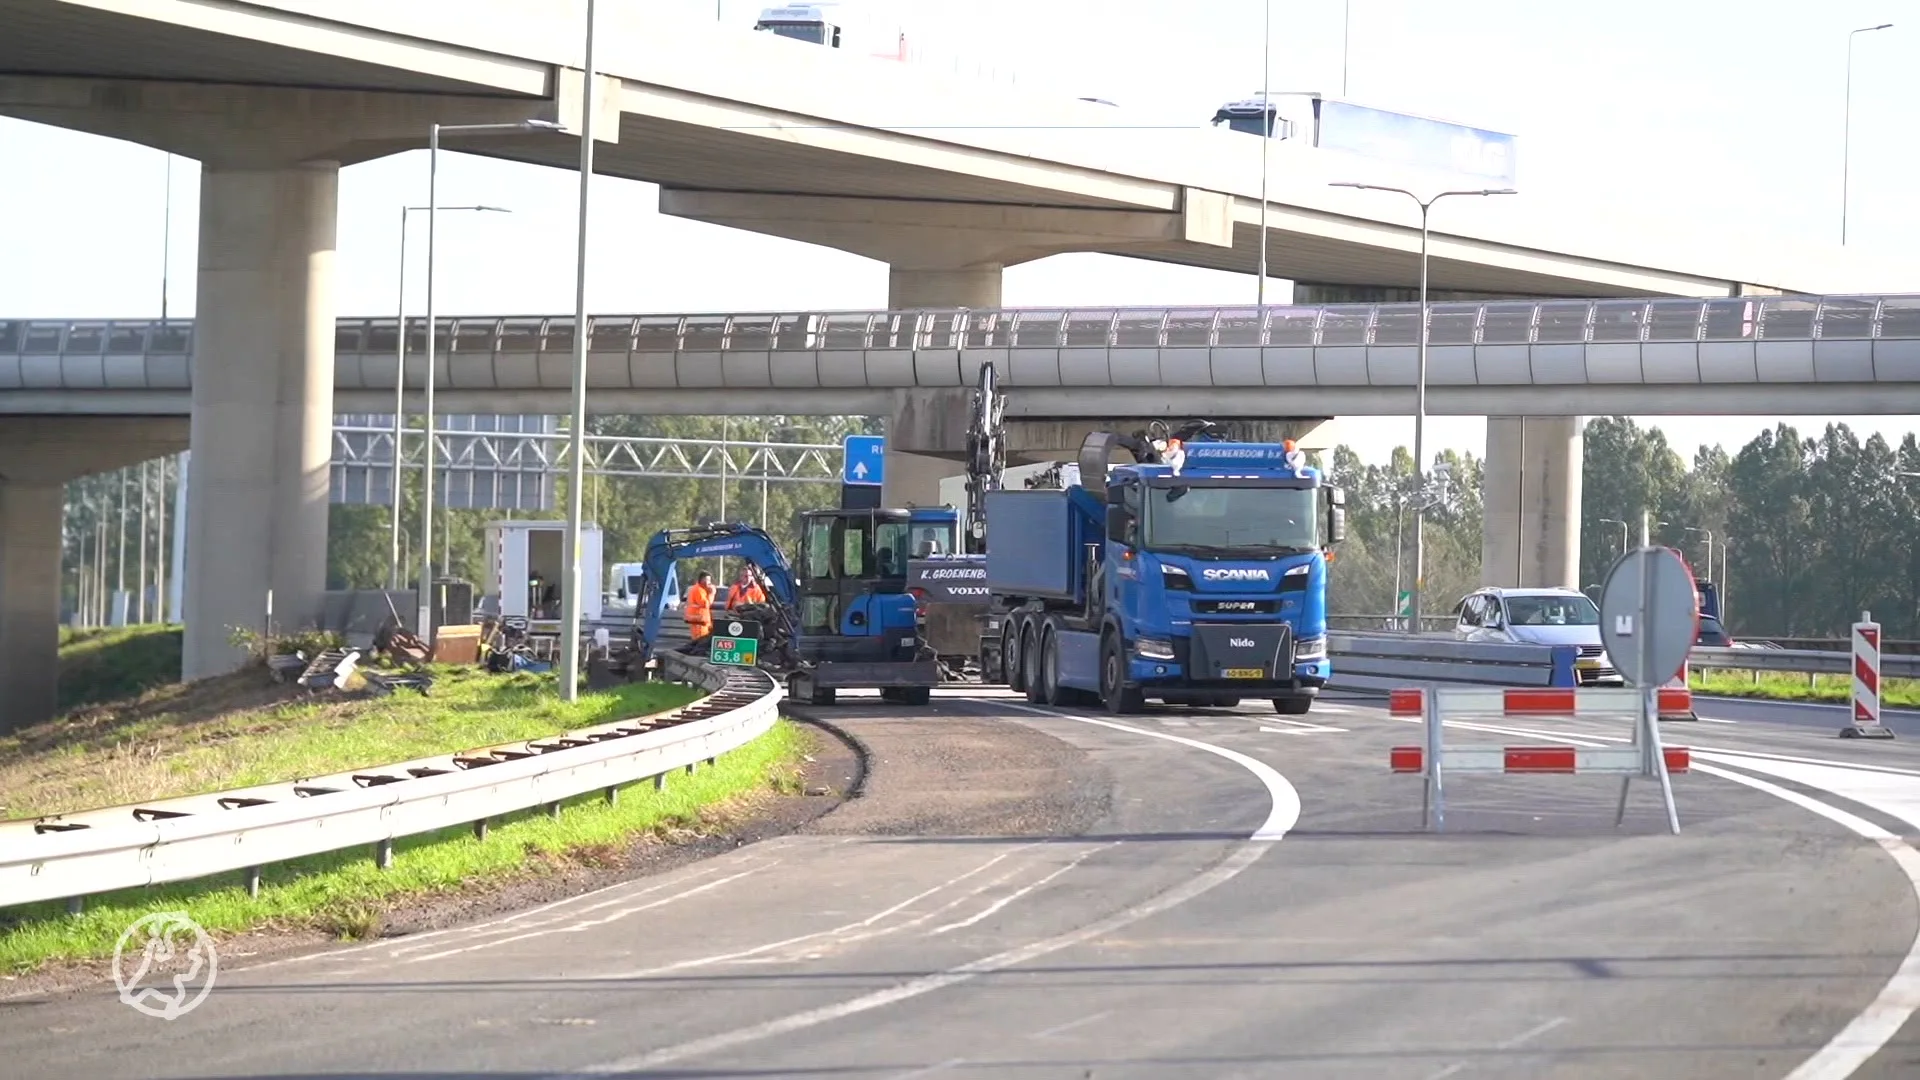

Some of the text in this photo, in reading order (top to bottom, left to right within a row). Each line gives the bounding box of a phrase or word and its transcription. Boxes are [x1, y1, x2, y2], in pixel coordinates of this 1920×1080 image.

[1198, 449, 1264, 458] GROENENBOOM
[1203, 569, 1269, 580] SCANIA
[717, 641, 733, 649] A15
[1230, 638, 1255, 647] Nido
